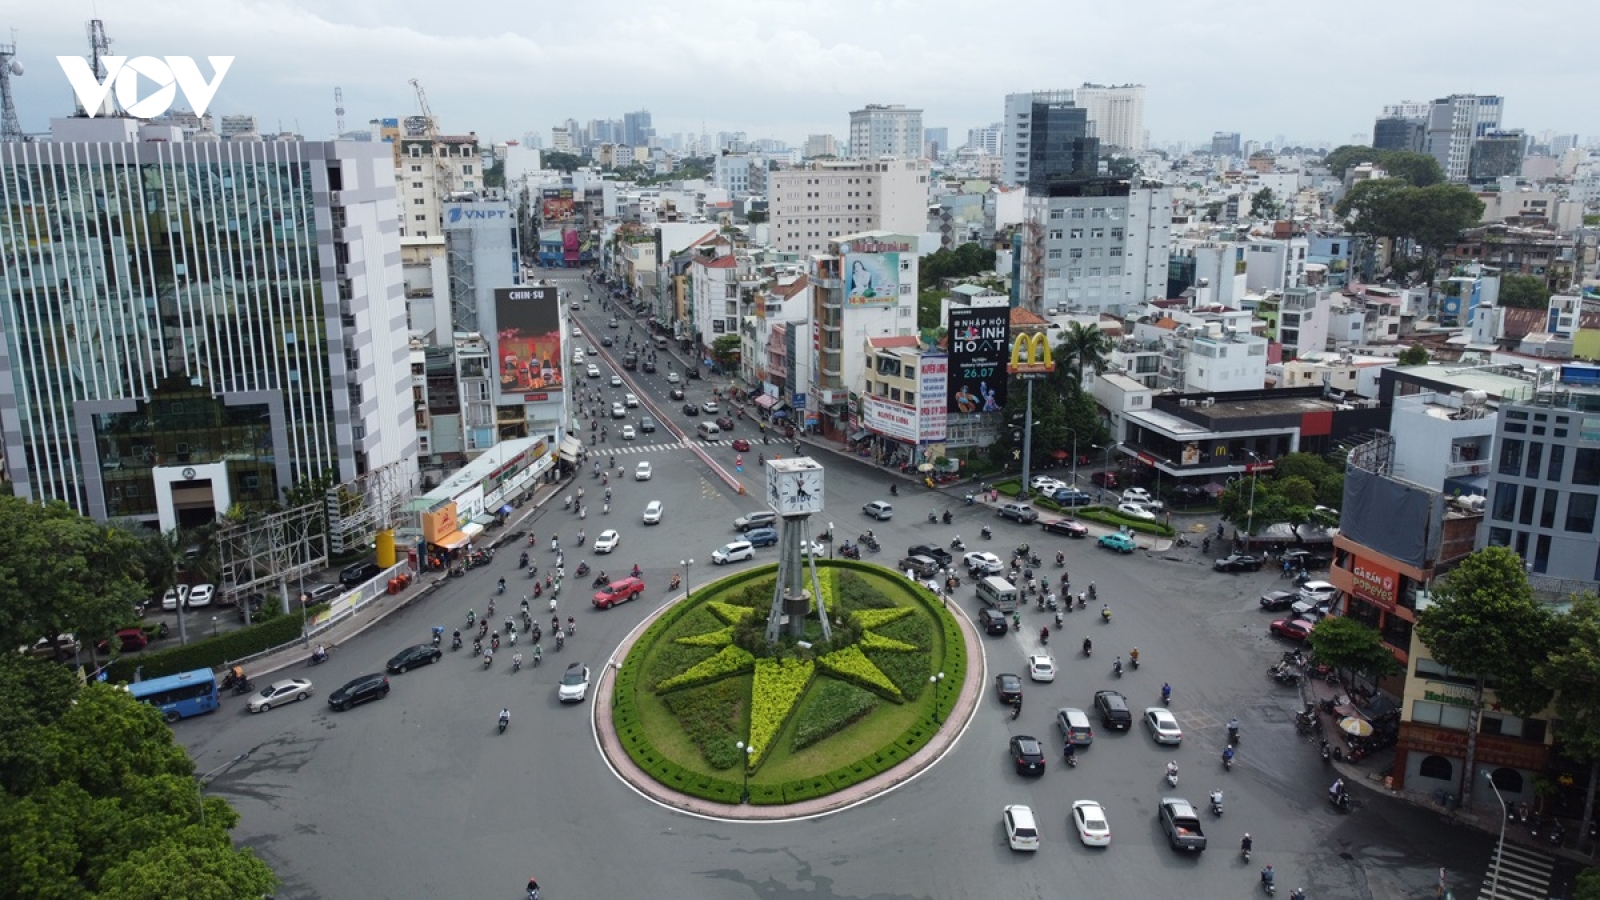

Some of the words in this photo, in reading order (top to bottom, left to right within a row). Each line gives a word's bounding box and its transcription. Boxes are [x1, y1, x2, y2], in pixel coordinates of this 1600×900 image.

[464, 210, 506, 220] VNPT
[509, 290, 544, 300] CHIN-SU
[963, 368, 994, 378] 26.07
[1354, 567, 1365, 578] GÀ
[1365, 571, 1381, 584] RÁN
